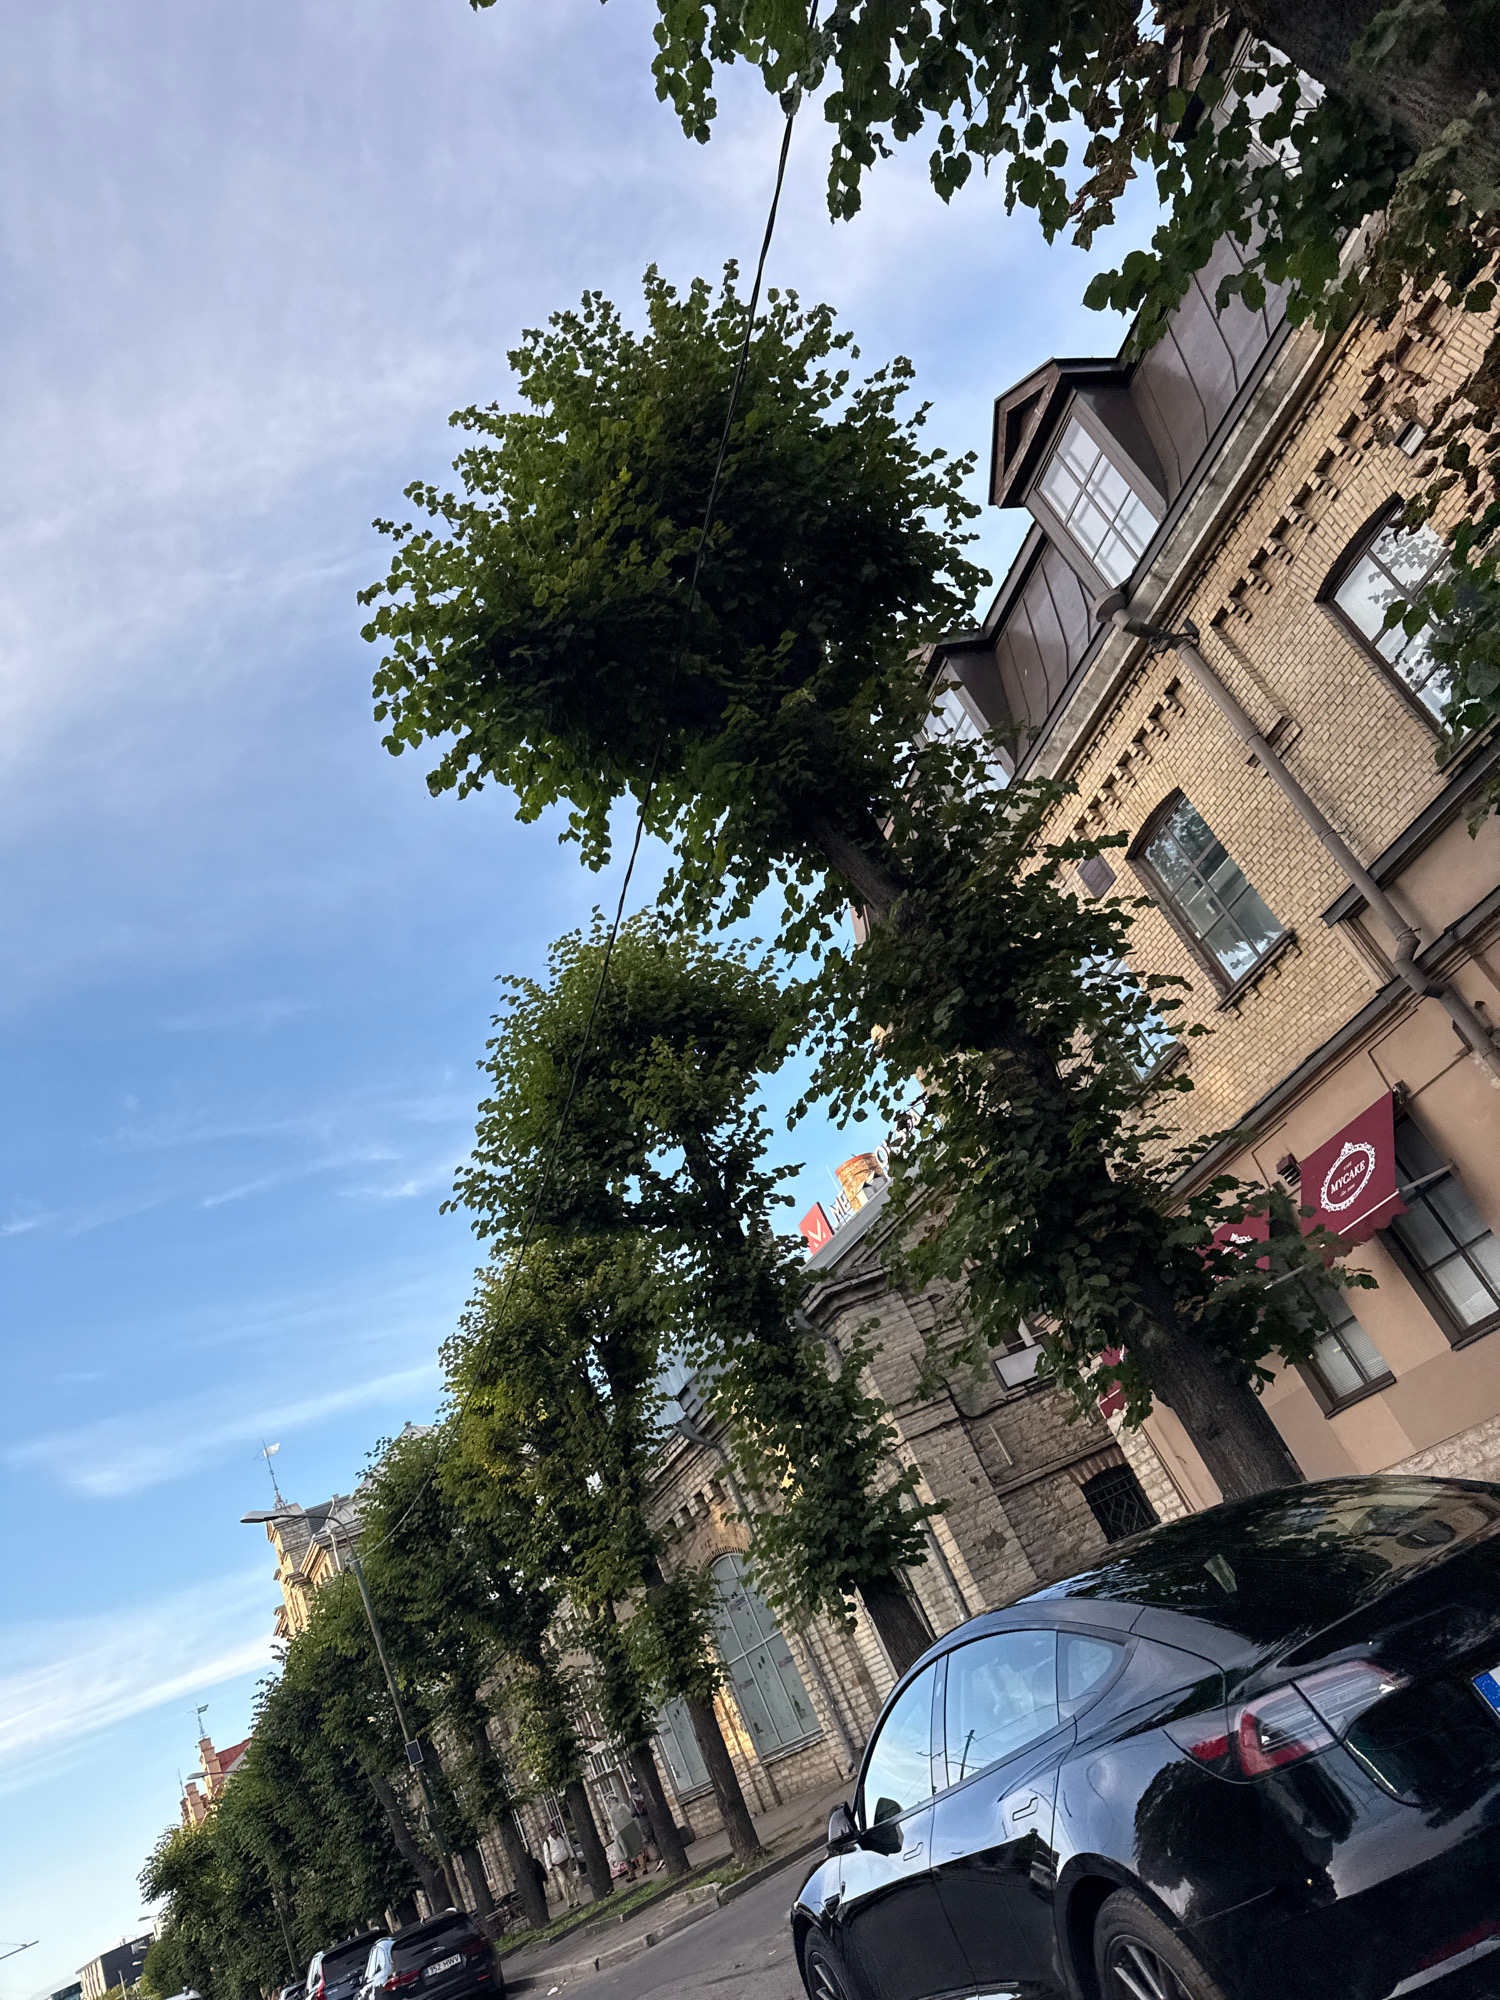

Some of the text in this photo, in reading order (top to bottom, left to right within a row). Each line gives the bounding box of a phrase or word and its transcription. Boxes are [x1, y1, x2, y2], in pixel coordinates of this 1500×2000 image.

[1331, 1160, 1366, 1194] MYCAKE
[429, 1963, 441, 1974] 352
[443, 1954, 459, 1967] HWV
